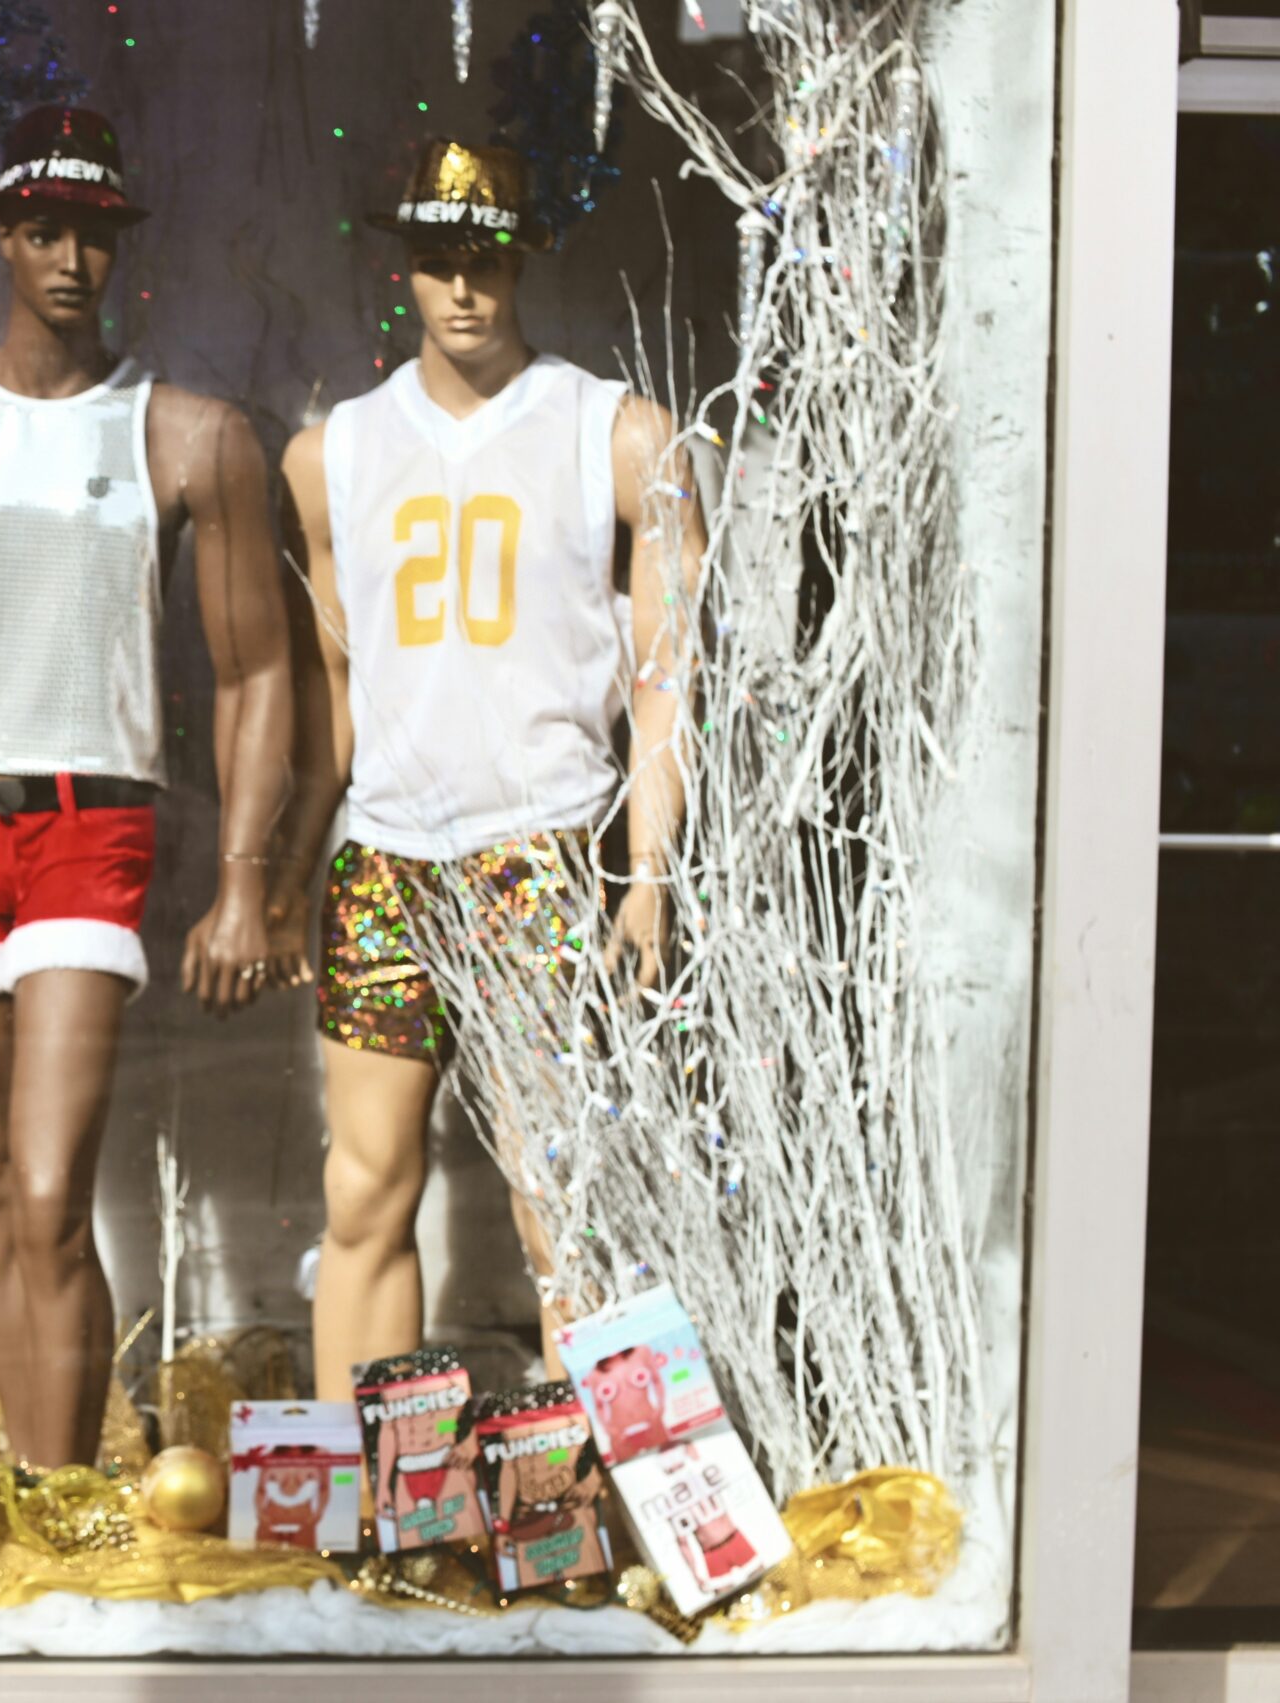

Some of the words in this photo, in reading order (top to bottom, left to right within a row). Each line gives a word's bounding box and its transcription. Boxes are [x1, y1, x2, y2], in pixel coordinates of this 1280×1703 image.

[46, 158, 104, 182] NEW
[414, 200, 467, 223] NEW
[393, 494, 521, 647] 20
[362, 1384, 469, 1425] FUNDIES
[484, 1424, 588, 1464] FUNDIES
[640, 1463, 724, 1522] mae
